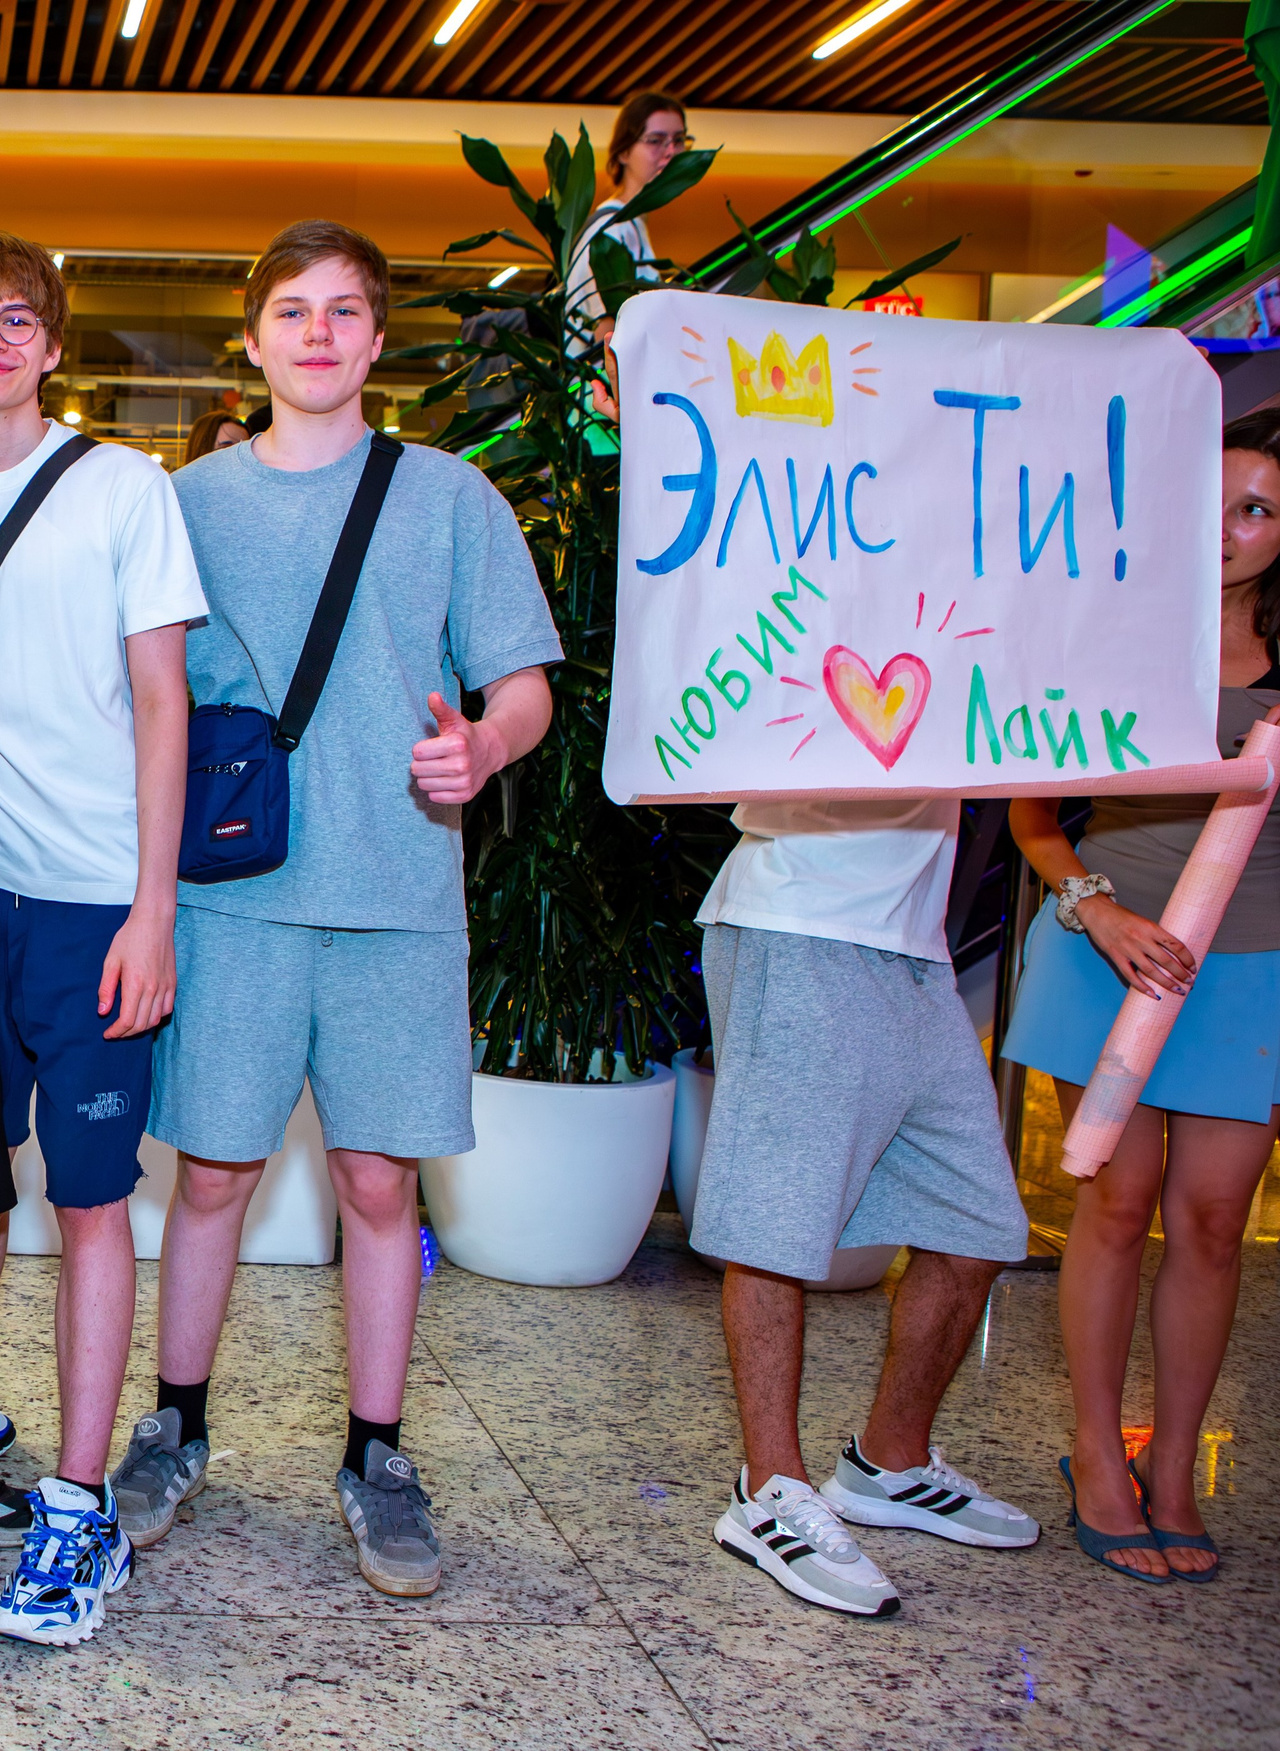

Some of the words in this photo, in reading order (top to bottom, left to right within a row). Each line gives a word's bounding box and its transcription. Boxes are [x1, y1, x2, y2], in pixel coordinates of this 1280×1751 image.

[636, 391, 896, 576] Элис
[965, 662, 1151, 773] Лайк
[216, 824, 246, 835] EASTPAK
[95, 1091, 117, 1104] THE
[77, 1100, 117, 1113] NORTH
[88, 1108, 117, 1120] FACE
